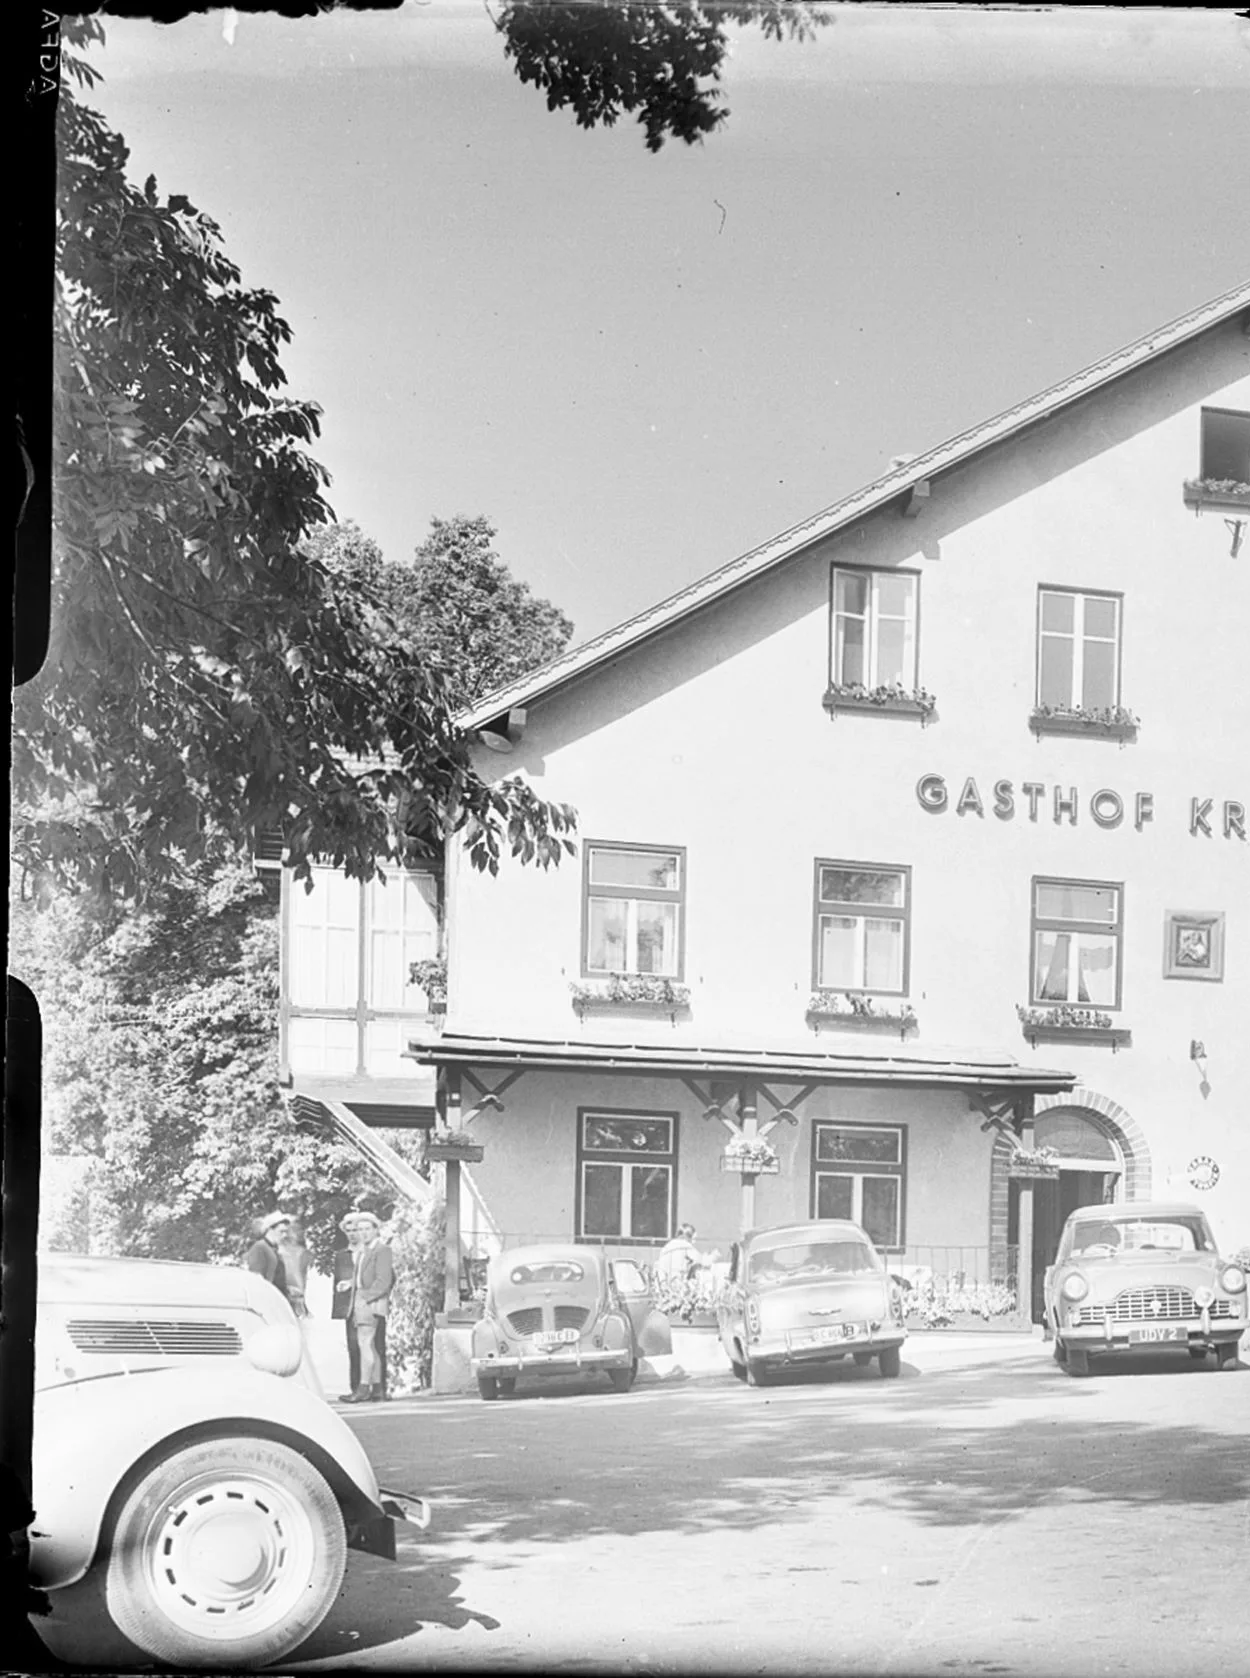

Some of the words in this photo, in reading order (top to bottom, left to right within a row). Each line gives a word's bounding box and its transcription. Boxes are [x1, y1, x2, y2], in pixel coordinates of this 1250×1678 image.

[40, 8, 60, 94] AGFA
[916, 772, 1153, 831] GASTHOF
[1168, 1327, 1178, 1340] 2
